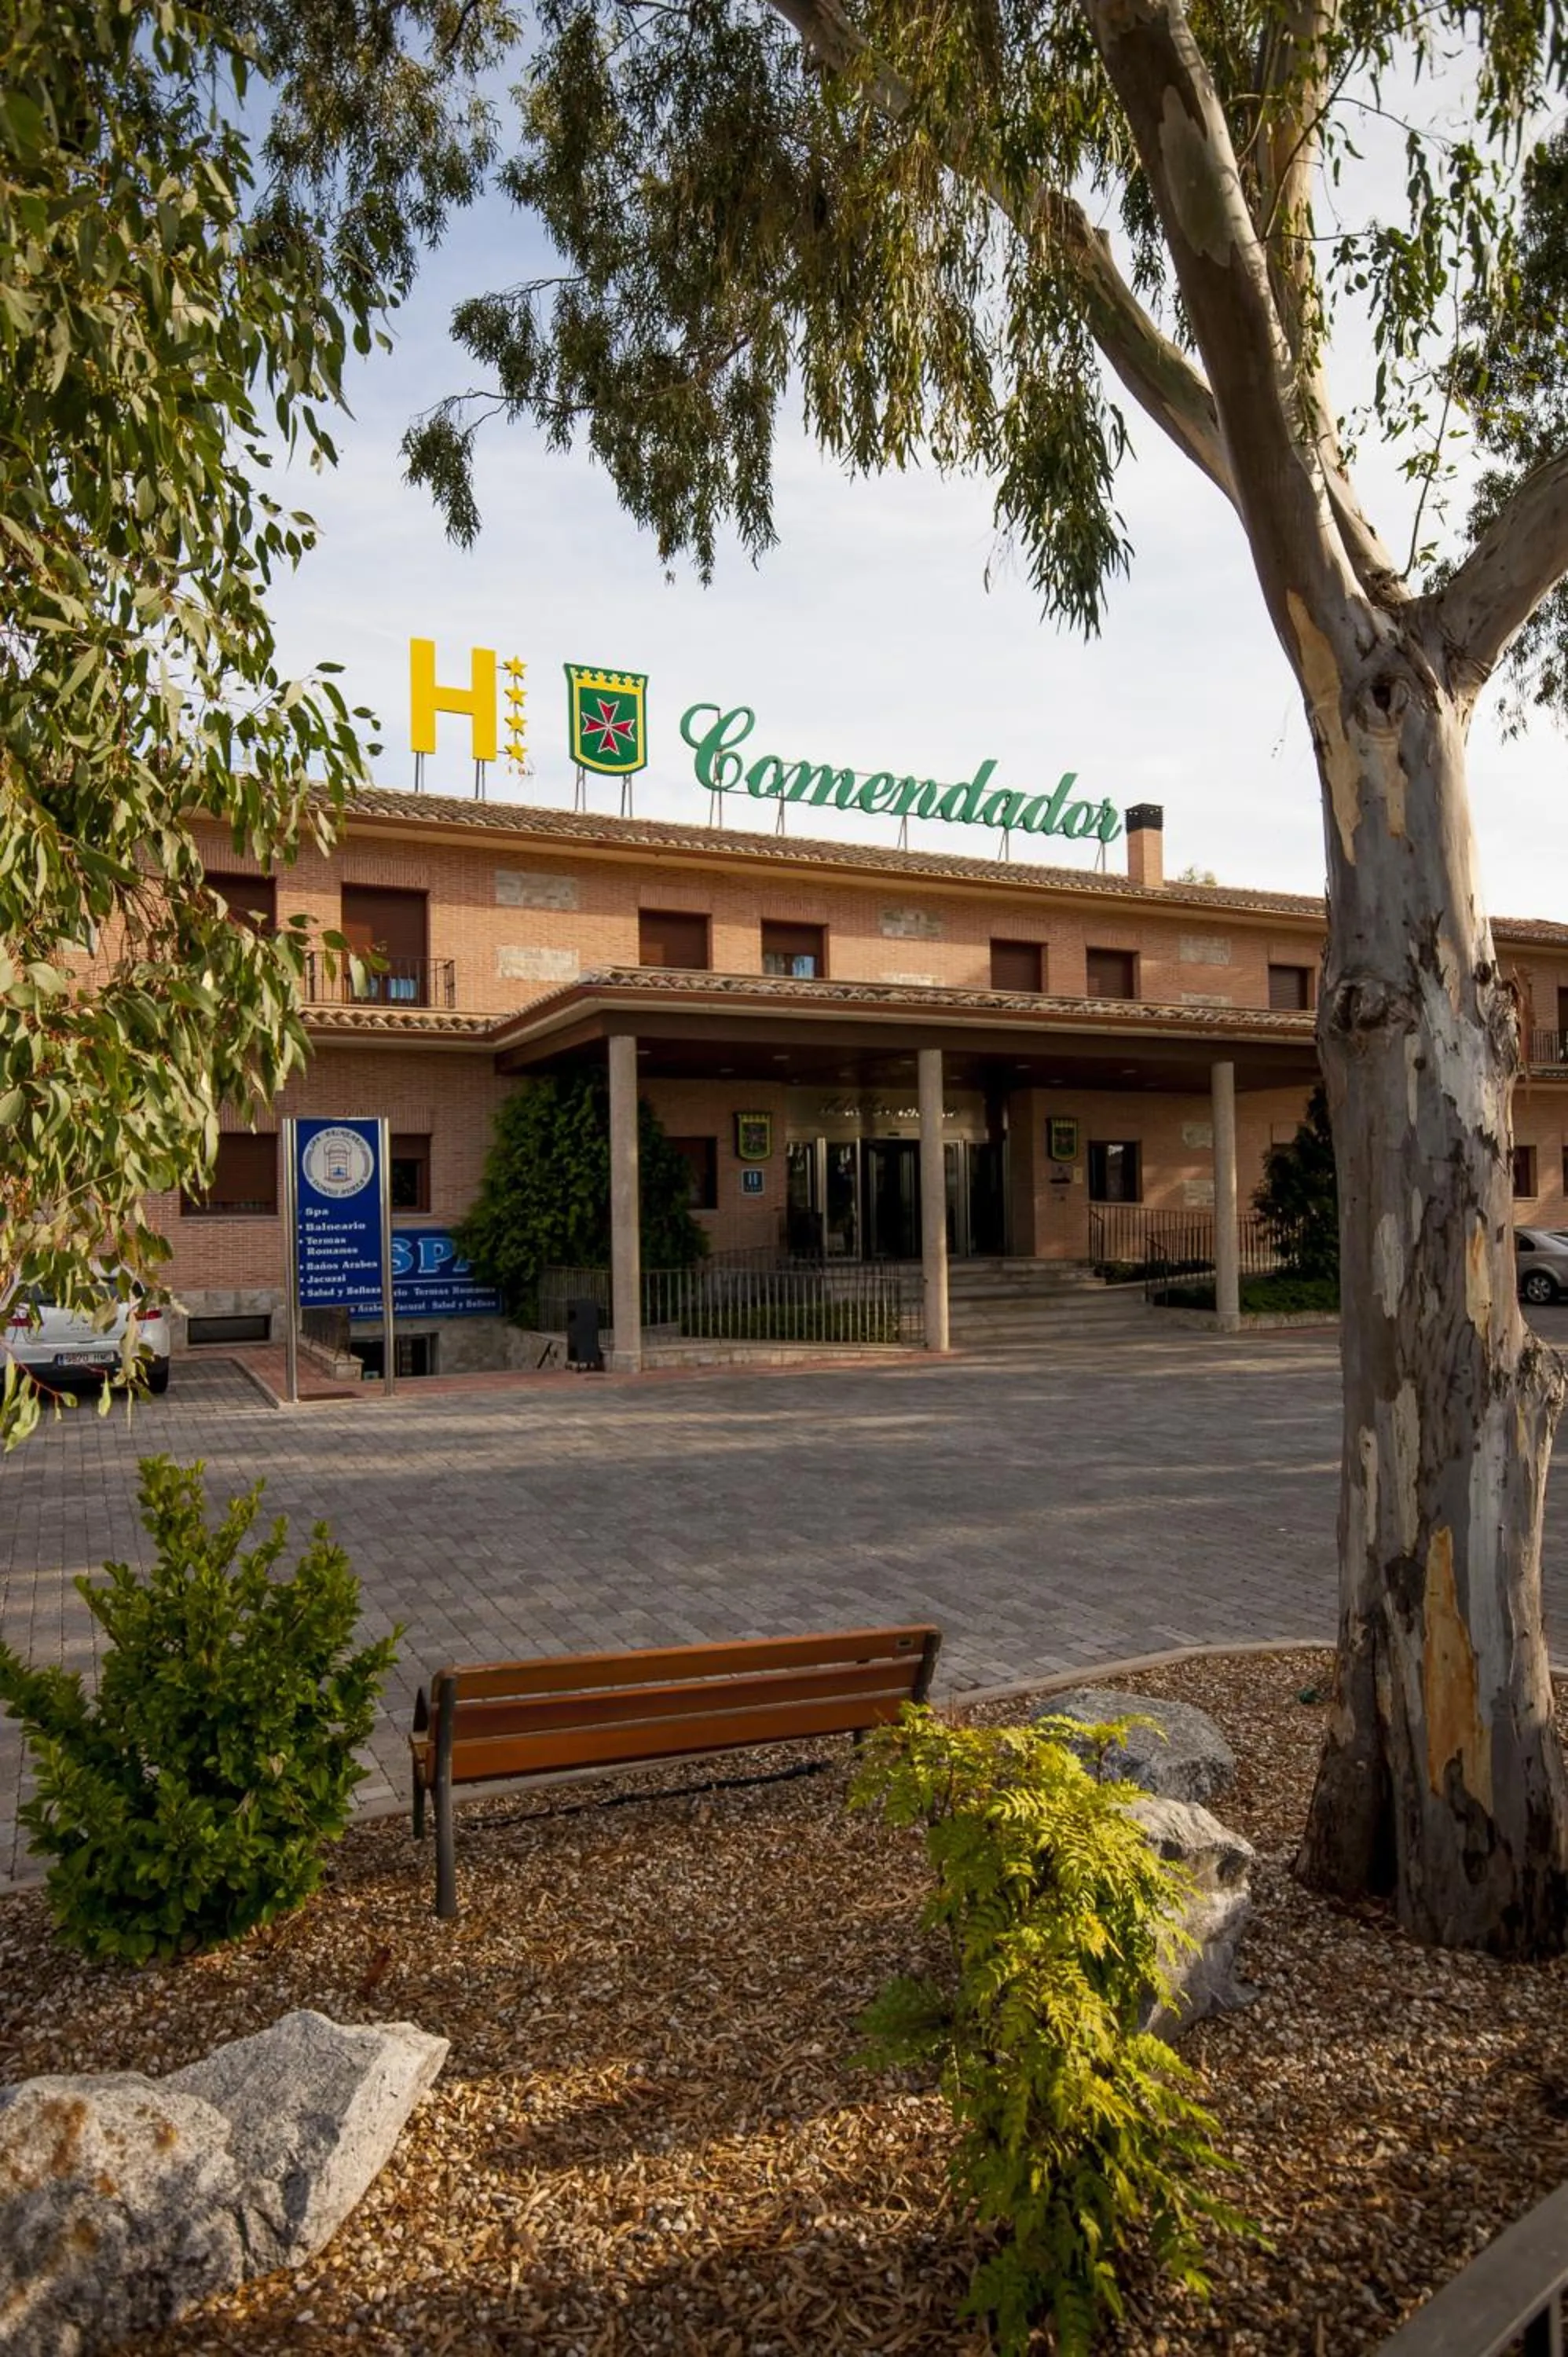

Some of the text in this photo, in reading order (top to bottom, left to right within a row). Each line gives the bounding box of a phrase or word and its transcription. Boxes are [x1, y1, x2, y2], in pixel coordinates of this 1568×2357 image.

[410, 637, 497, 762] H
[680, 702, 1122, 843] Comendador
[305, 1207, 329, 1217] Spa
[305, 1222, 366, 1231] Balneario
[306, 1236, 346, 1245] Termas
[306, 1262, 339, 1270] Baños
[306, 1274, 346, 1284] Jacuzzi
[307, 1285, 381, 1298] Salud y Belleza
[414, 1287, 449, 1296] Termas
[357, 1303, 383, 1313] Arabe
[394, 1302, 427, 1312] Jacuzzi
[431, 1300, 456, 1310] Salud
[458, 1302, 463, 1310] y
[466, 1299, 496, 1309] Belleza
